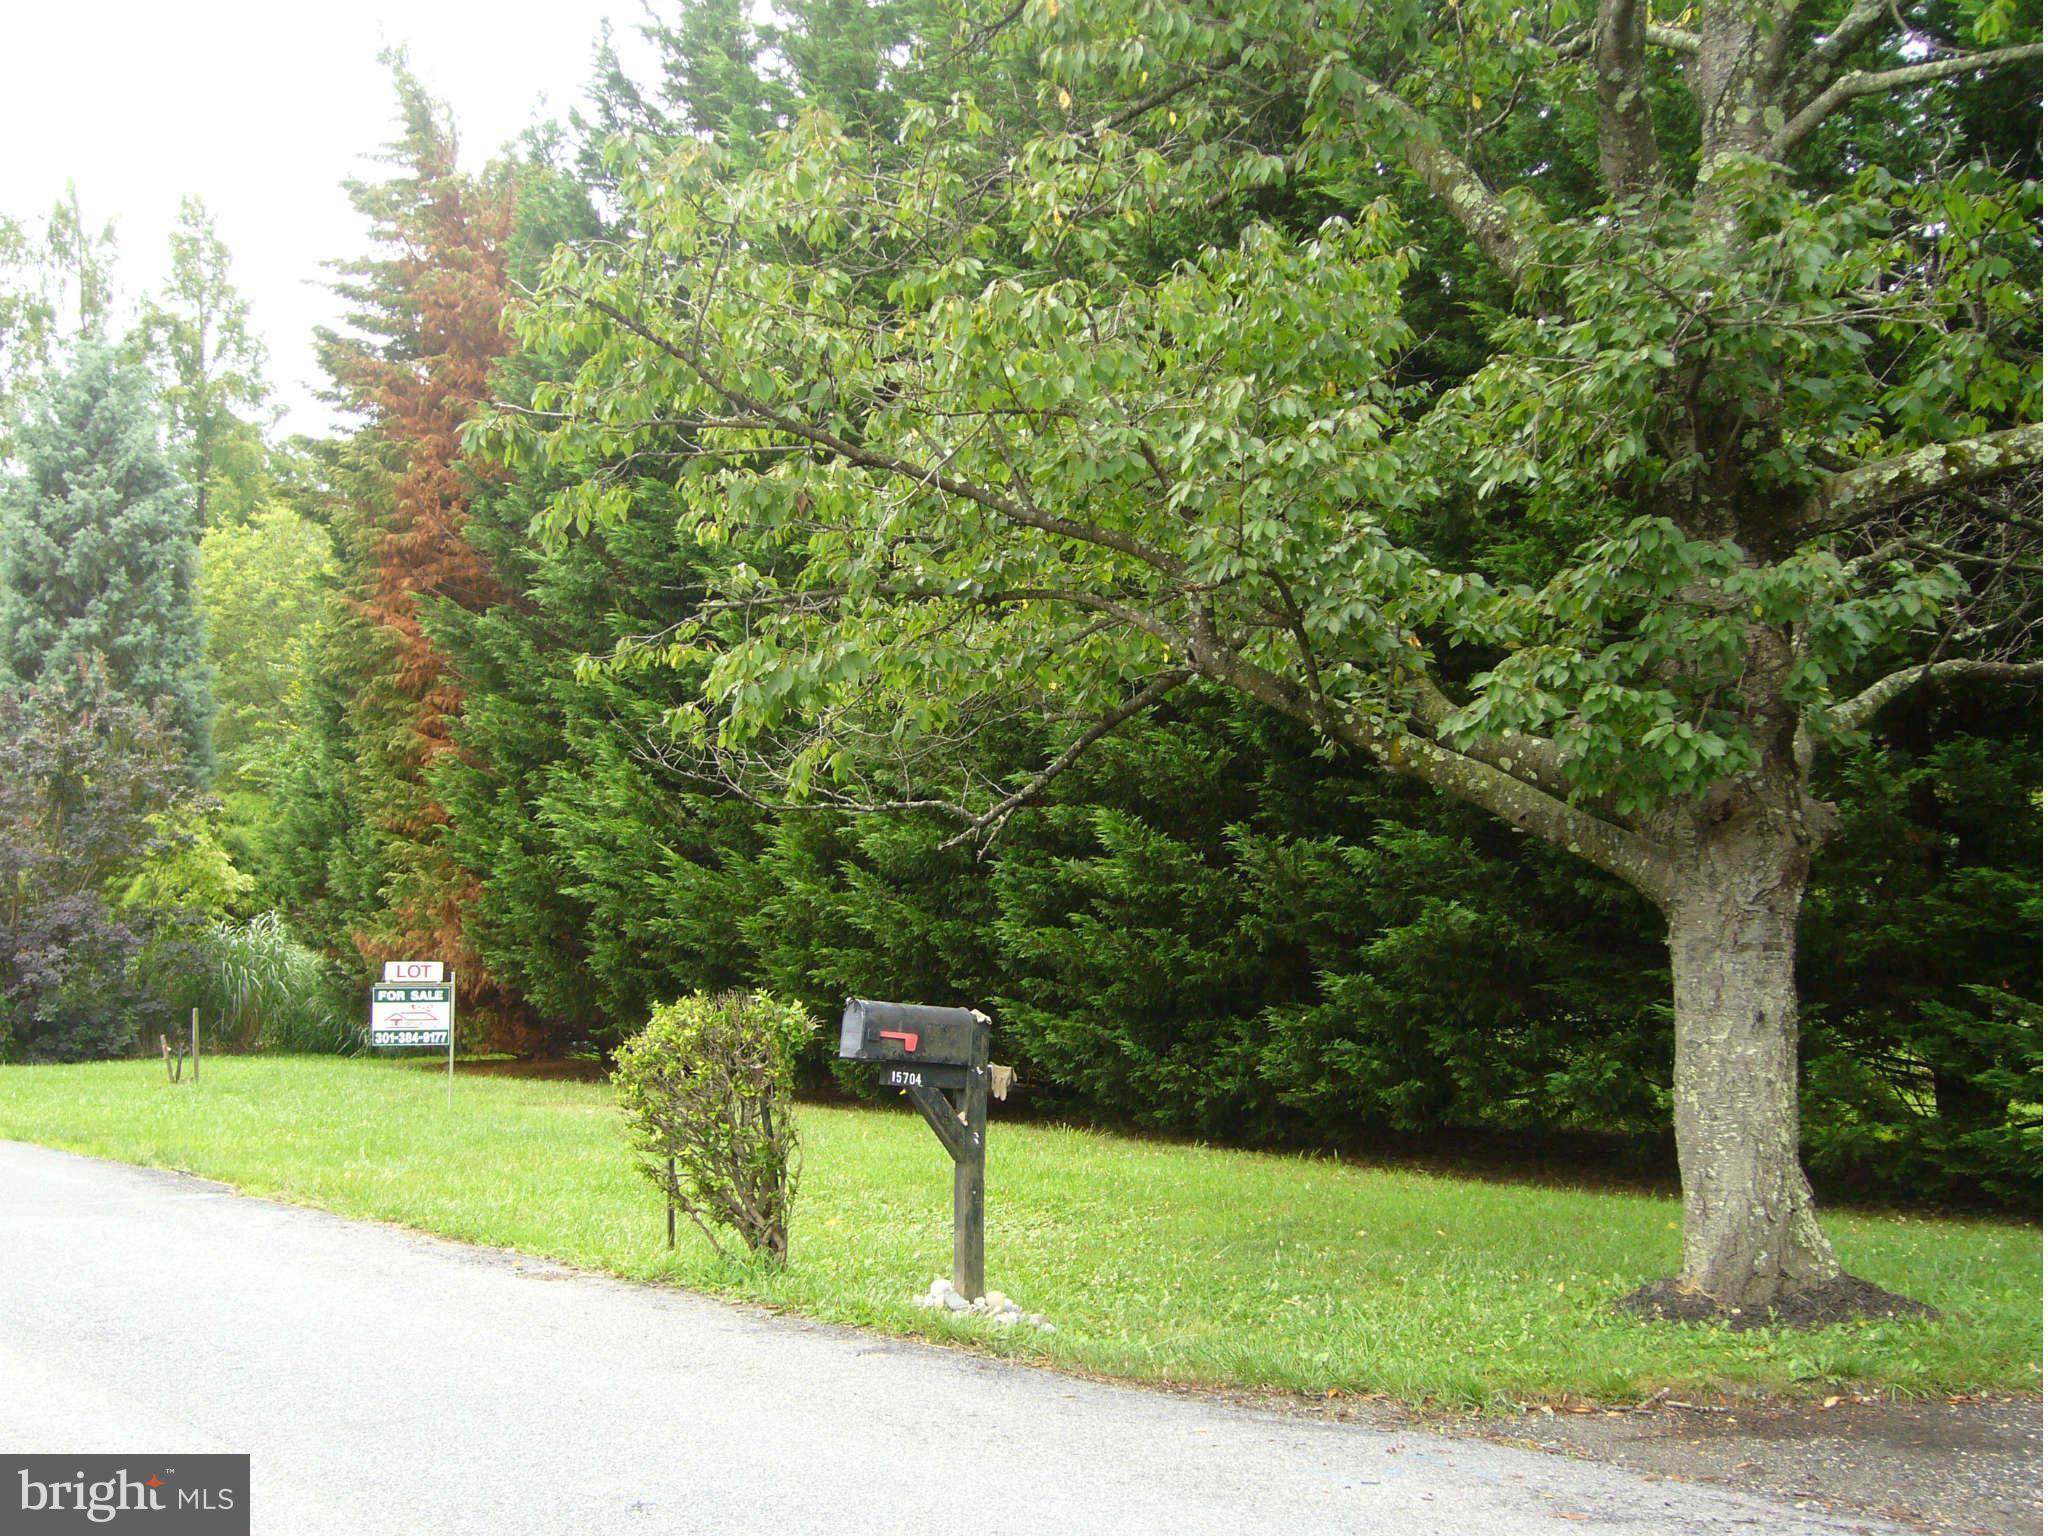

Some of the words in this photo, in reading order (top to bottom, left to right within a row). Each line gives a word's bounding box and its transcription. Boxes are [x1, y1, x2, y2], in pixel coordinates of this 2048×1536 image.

[396, 965, 432, 978] LOT
[378, 990, 406, 1001] FOR
[410, 990, 444, 1001] SALE
[891, 1070, 922, 1086] 15704
